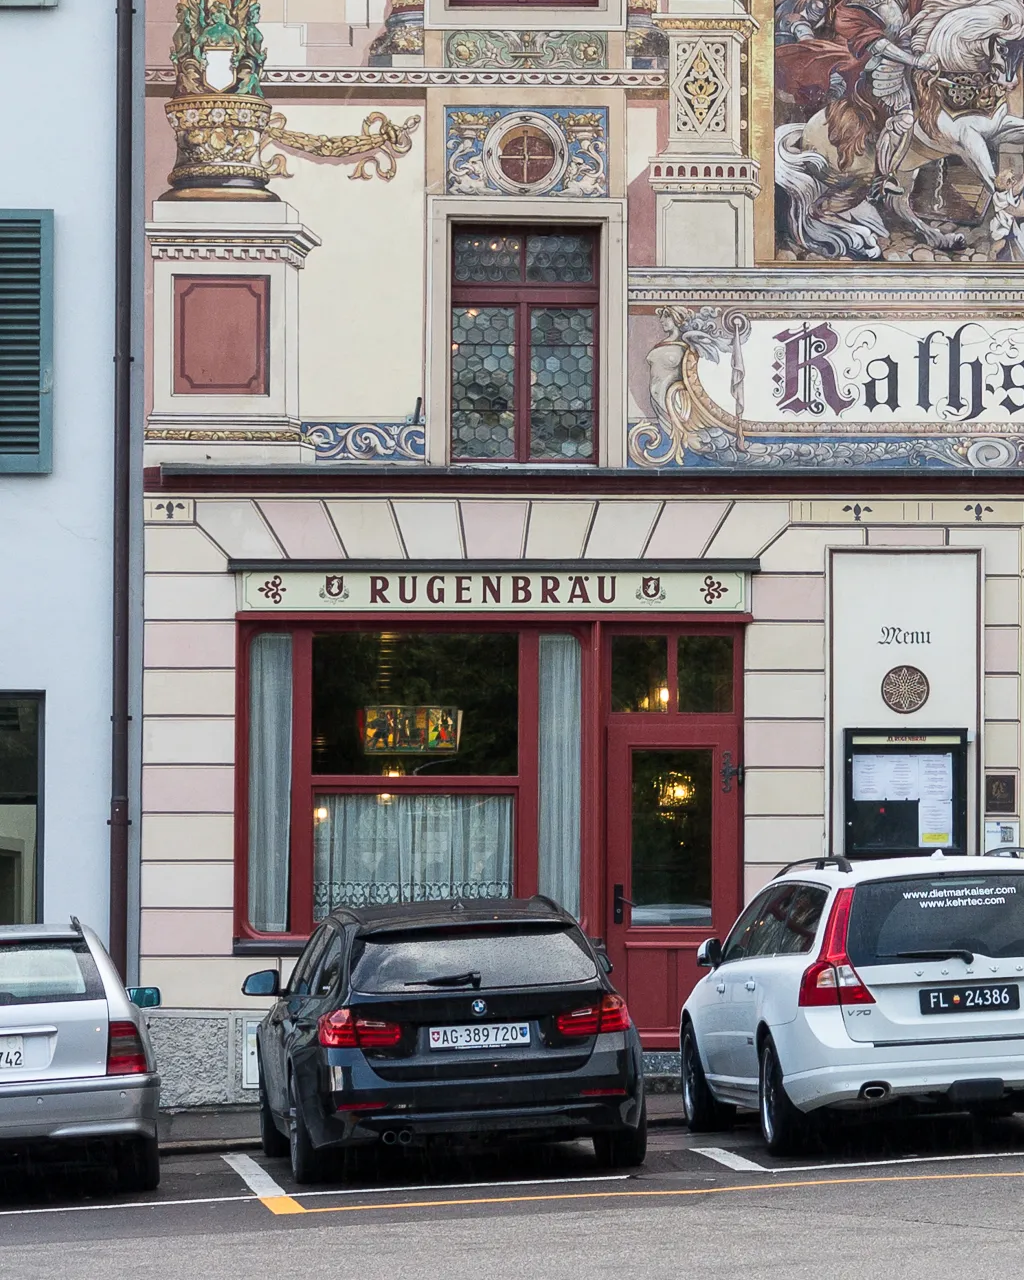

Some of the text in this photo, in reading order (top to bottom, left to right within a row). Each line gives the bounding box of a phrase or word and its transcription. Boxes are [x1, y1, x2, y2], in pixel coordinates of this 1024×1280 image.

[369, 575, 618, 604] RUGENBRÄU
[877, 626, 932, 645] Menu
[903, 886, 1017, 900] www.dietmarkaiser.com
[919, 896, 1006, 909] www.kehrtec.com
[929, 988, 1010, 1009] FL 24386
